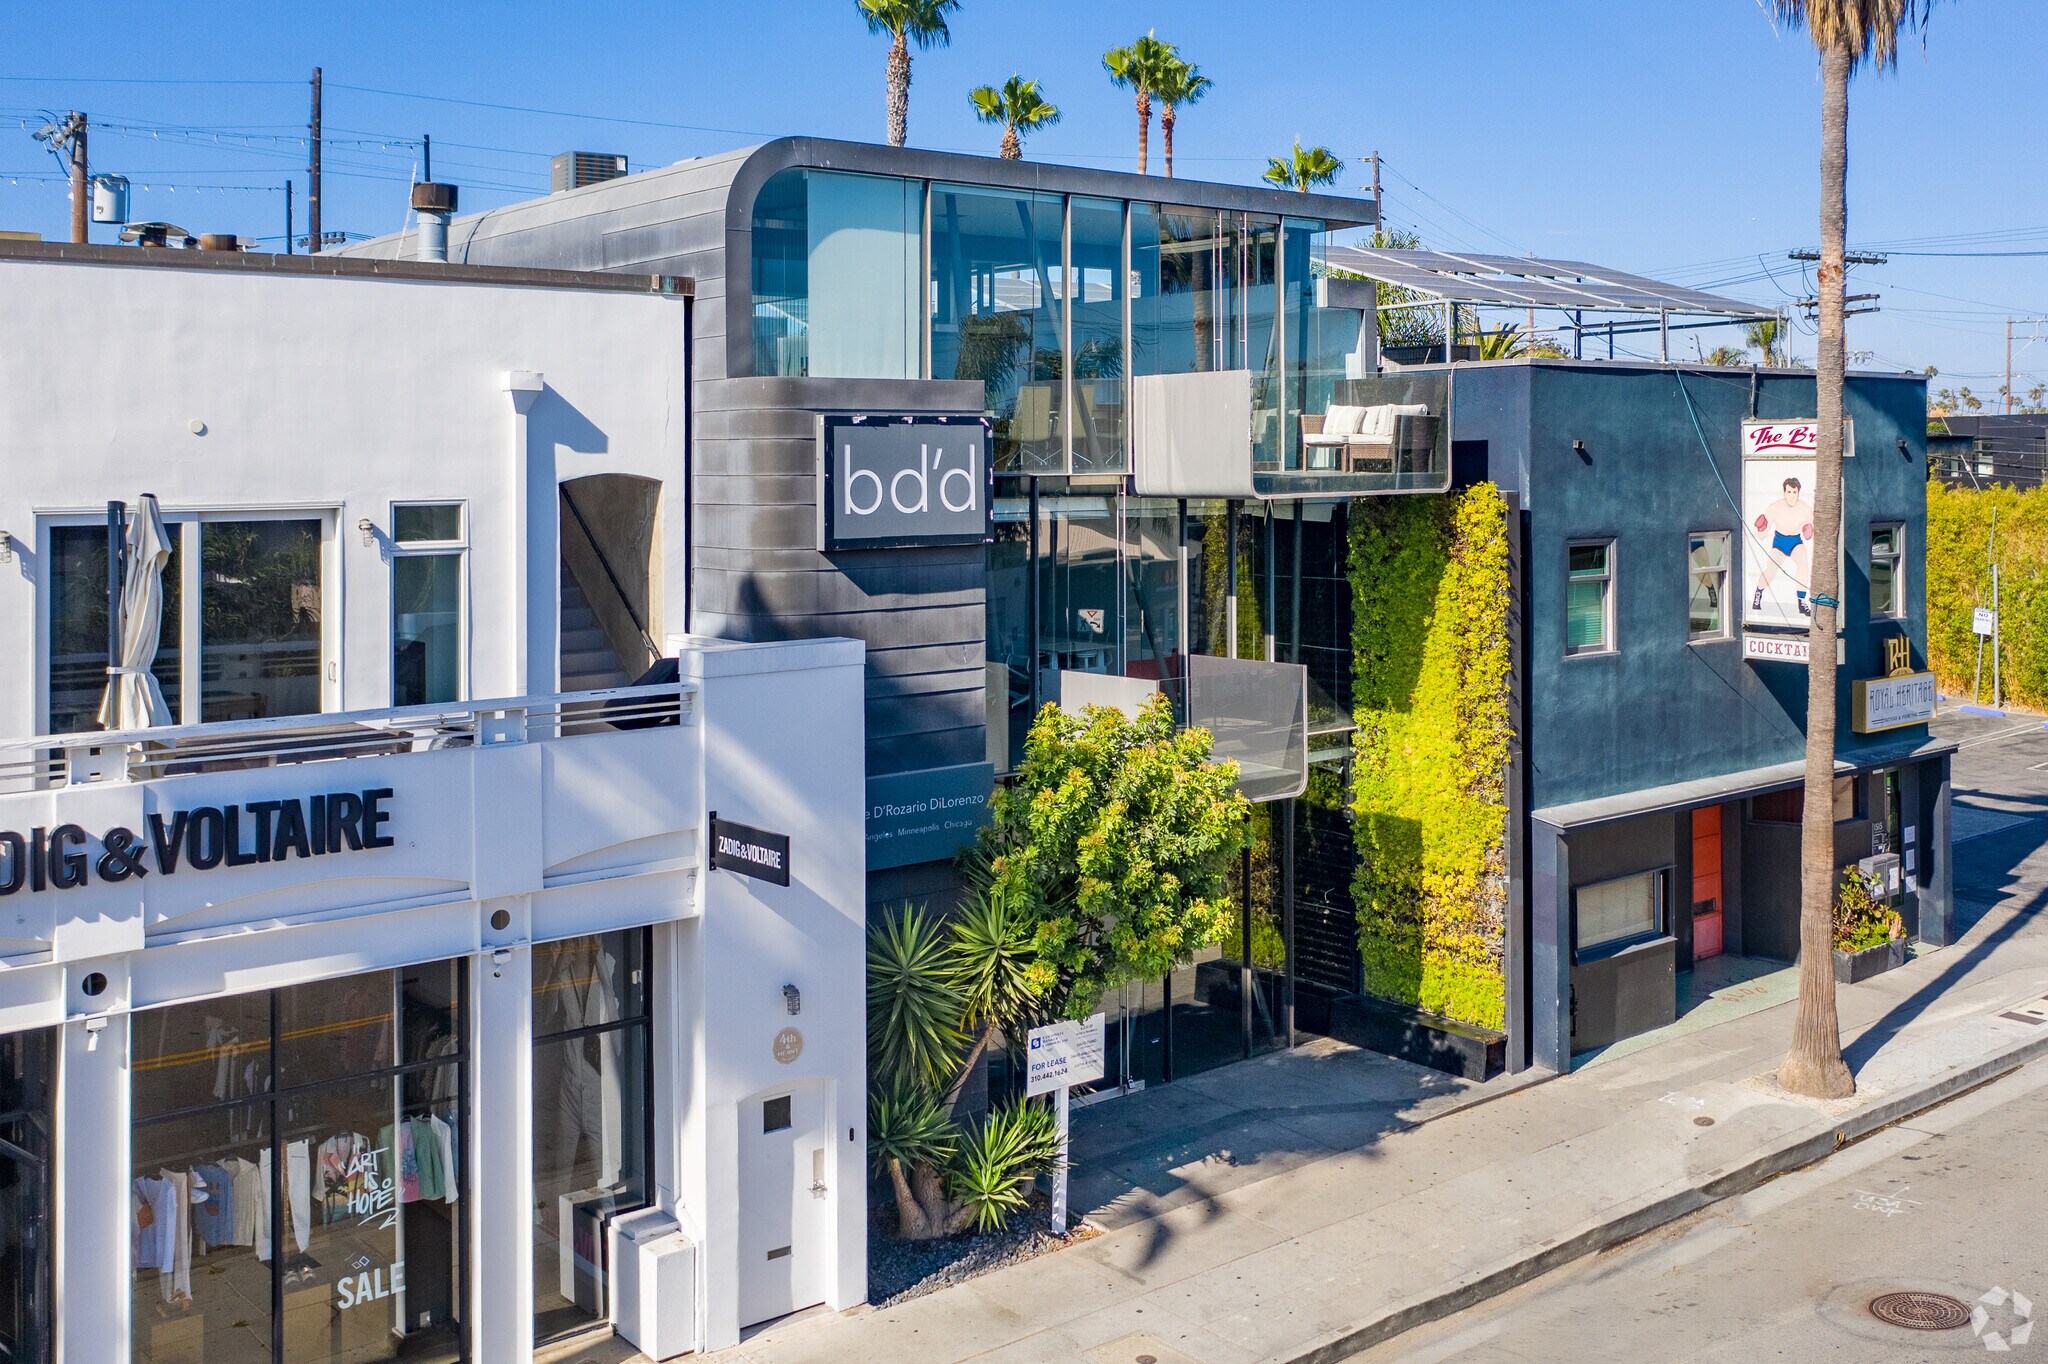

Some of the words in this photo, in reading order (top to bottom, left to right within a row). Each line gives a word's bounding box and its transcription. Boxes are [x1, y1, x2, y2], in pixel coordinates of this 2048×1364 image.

[1749, 425, 1783, 446] The
[1788, 426, 1817, 445] Br
[1749, 640, 1808, 657] COCKTAI
[1869, 687, 1894, 713] ROYAL
[1896, 680, 1934, 708] HERITAGE
[873, 801, 927, 819] D'Rozario
[930, 795, 984, 810] DiLorenzo
[898, 824, 940, 837] Minneapolis
[944, 820, 972, 829] Chicago
[1031, 1061, 1046, 1072] FOR
[1047, 1056, 1067, 1068] LEASE
[1030, 1068, 1068, 1083] 310.442.1624
[364, 1171, 379, 1189] IS
[337, 1260, 406, 1310] SALE
